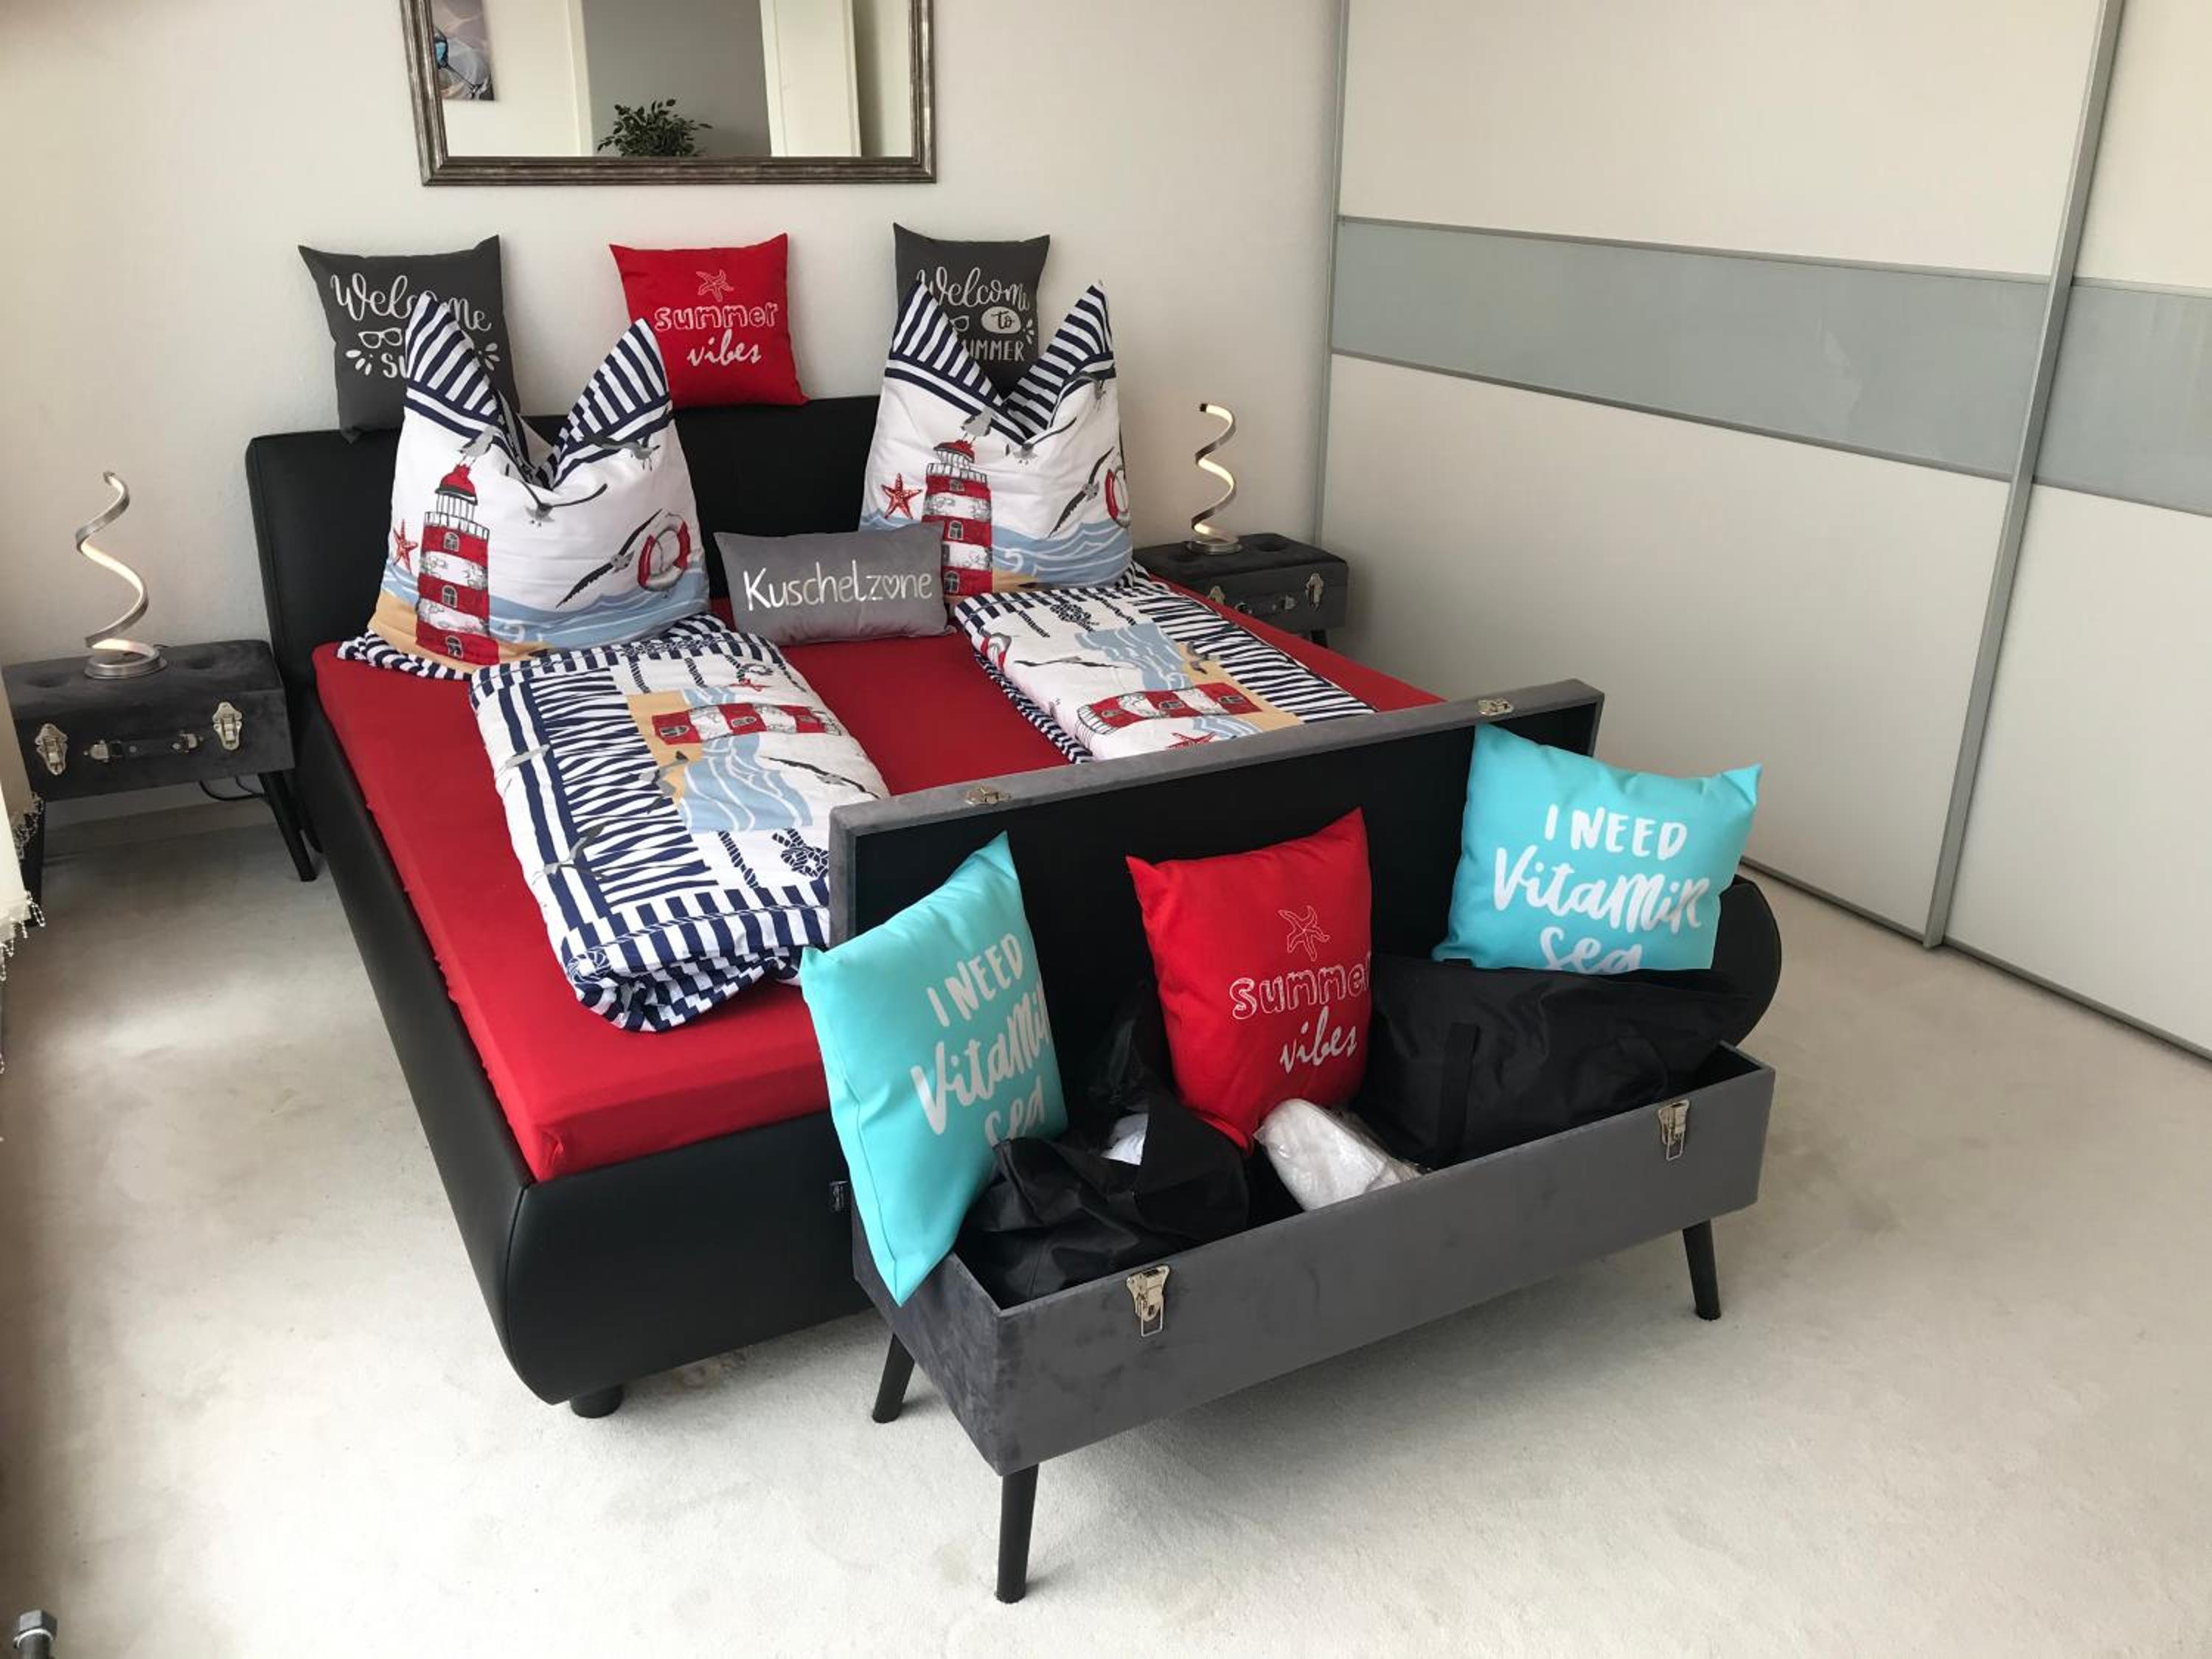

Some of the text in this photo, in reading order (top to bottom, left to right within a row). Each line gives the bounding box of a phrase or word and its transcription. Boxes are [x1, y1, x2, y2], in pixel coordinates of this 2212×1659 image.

[686, 328, 762, 366] vibes
[1544, 803, 1688, 860] I NEED
[927, 932, 1023, 1028] I NEED
[1279, 1005, 1357, 1074] vibes
